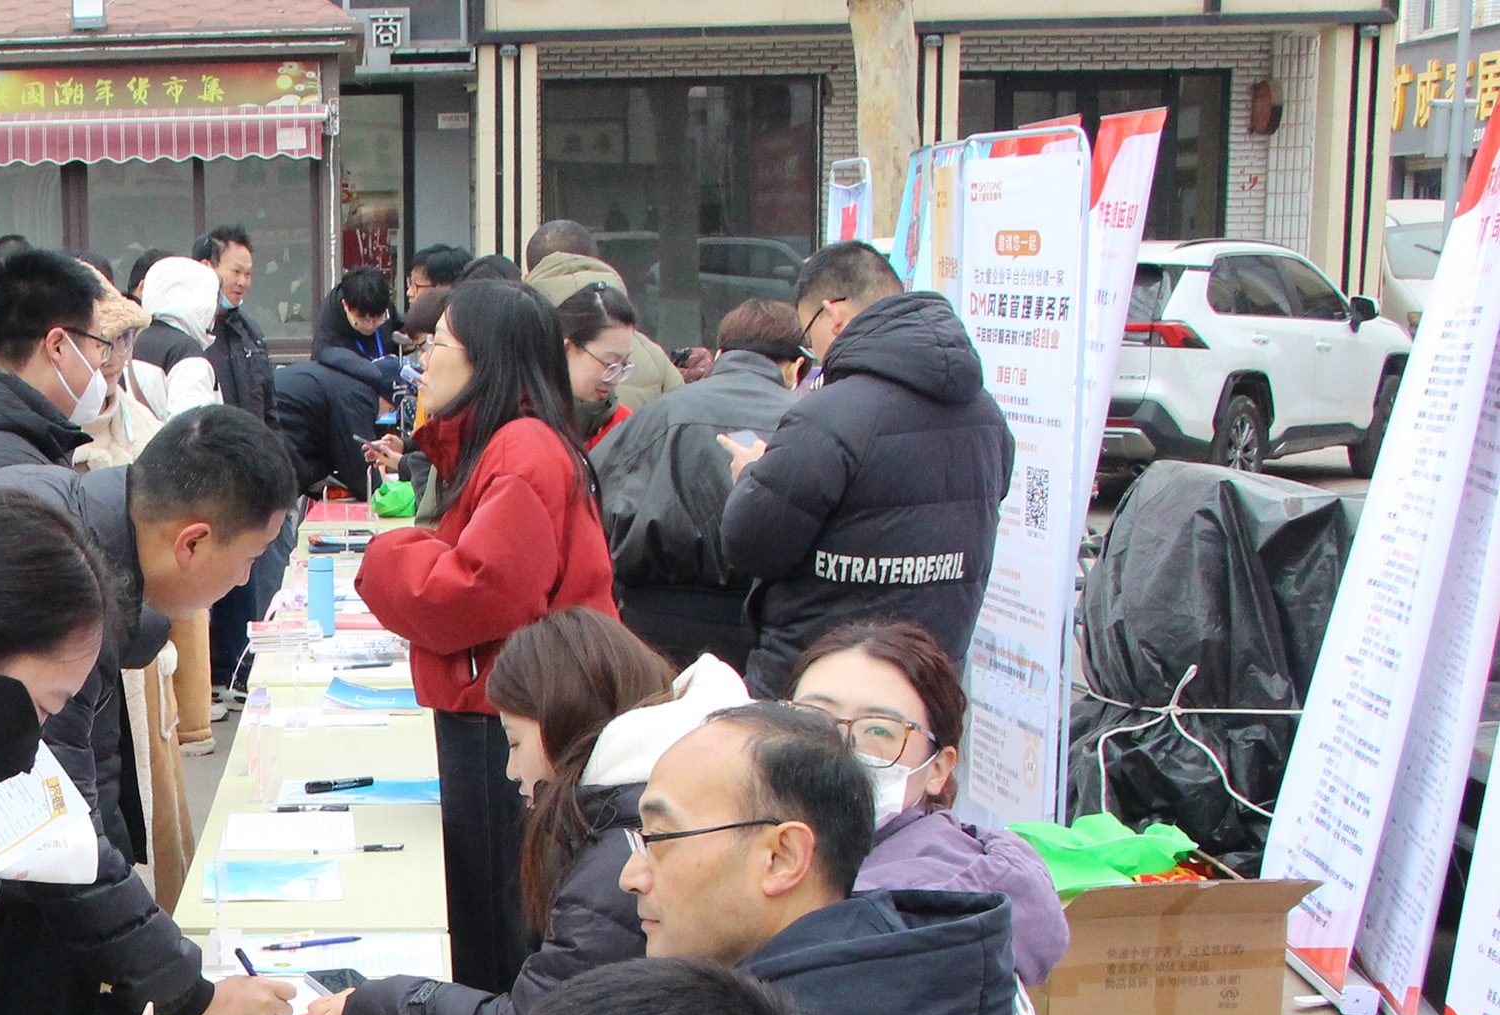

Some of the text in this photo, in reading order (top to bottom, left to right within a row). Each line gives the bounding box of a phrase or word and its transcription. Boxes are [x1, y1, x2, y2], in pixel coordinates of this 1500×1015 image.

[369, 10, 404, 48] 商
[997, 234, 1038, 252] 邀请您一起
